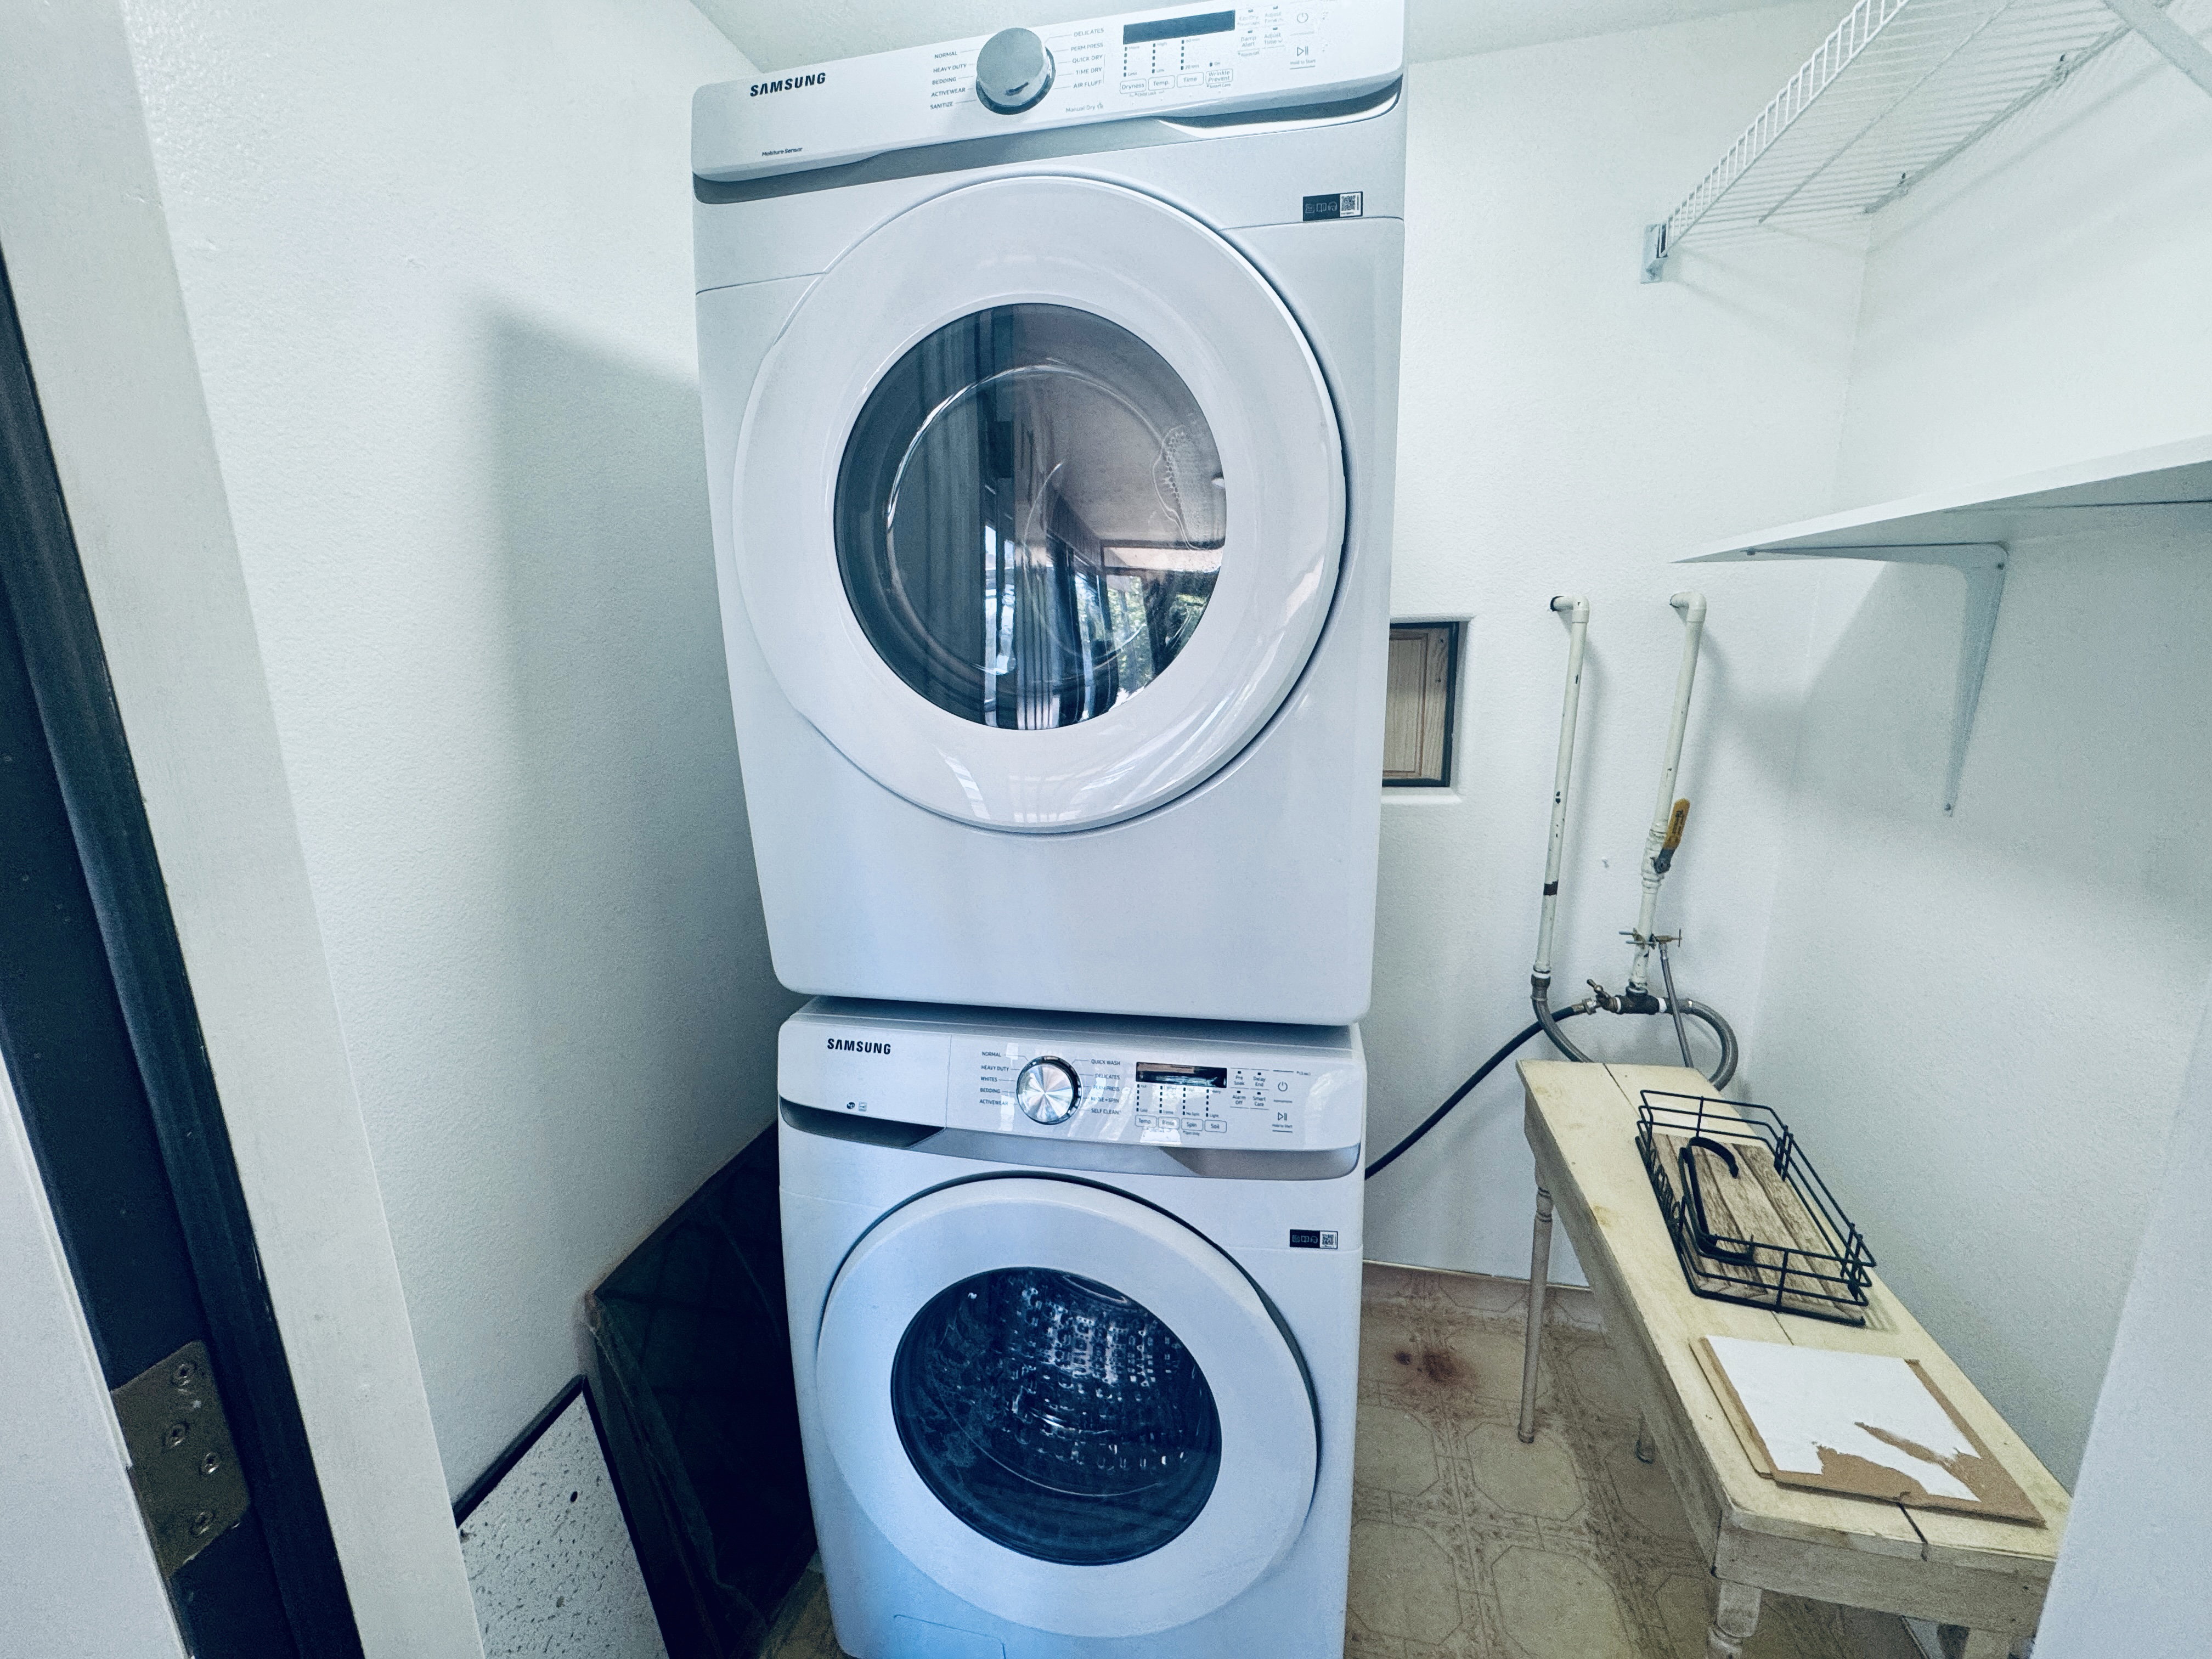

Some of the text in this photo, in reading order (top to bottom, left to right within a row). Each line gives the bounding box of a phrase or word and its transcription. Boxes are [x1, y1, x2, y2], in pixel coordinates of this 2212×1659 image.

[1074, 27, 1104, 37] DELICATES
[934, 50, 957, 59] NORMAL
[750, 72, 826, 97] SAMSUNG
[932, 77, 957, 86] BEDDING
[931, 87, 966, 98] ACTIVEWEAR
[930, 101, 953, 110] SANITIZE
[827, 1038, 891, 1055] SAMSUNG
